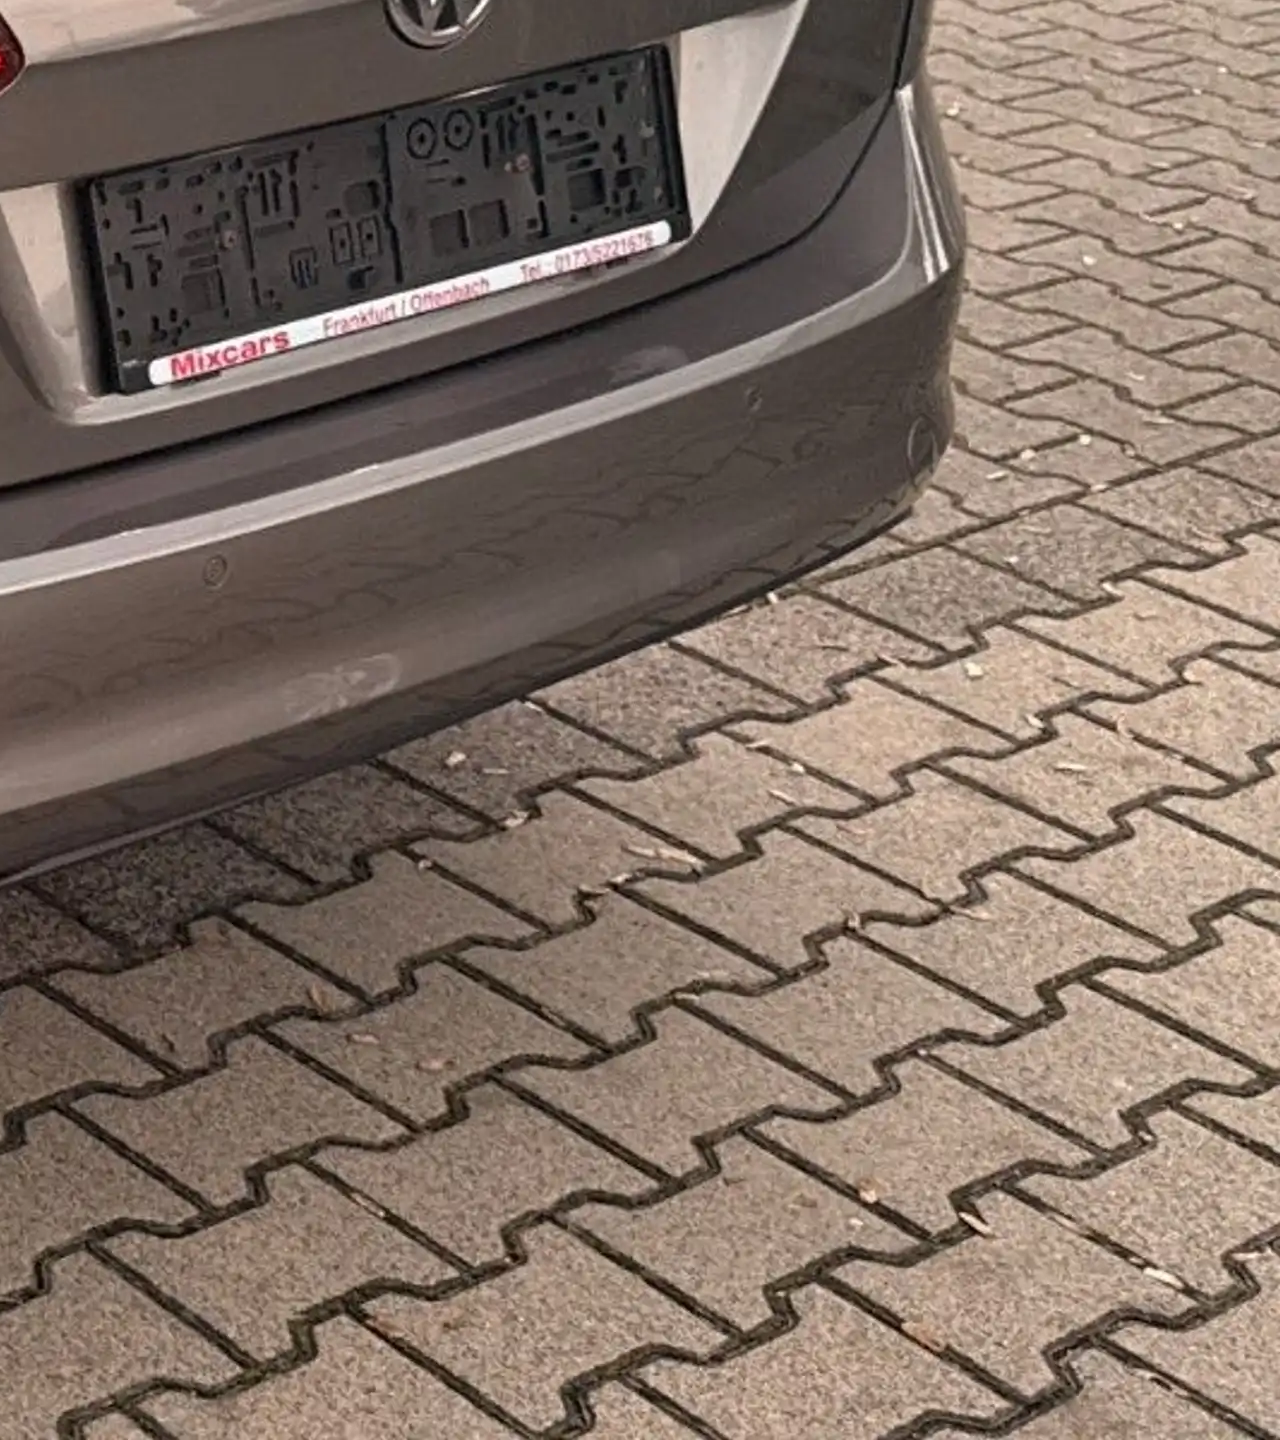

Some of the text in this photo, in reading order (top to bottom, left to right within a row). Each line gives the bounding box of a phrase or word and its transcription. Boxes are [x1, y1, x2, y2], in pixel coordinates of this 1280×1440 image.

[170, 330, 292, 378] Mixcars
[322, 302, 400, 338] Frankfurt
[410, 278, 490, 312] Offenbach
